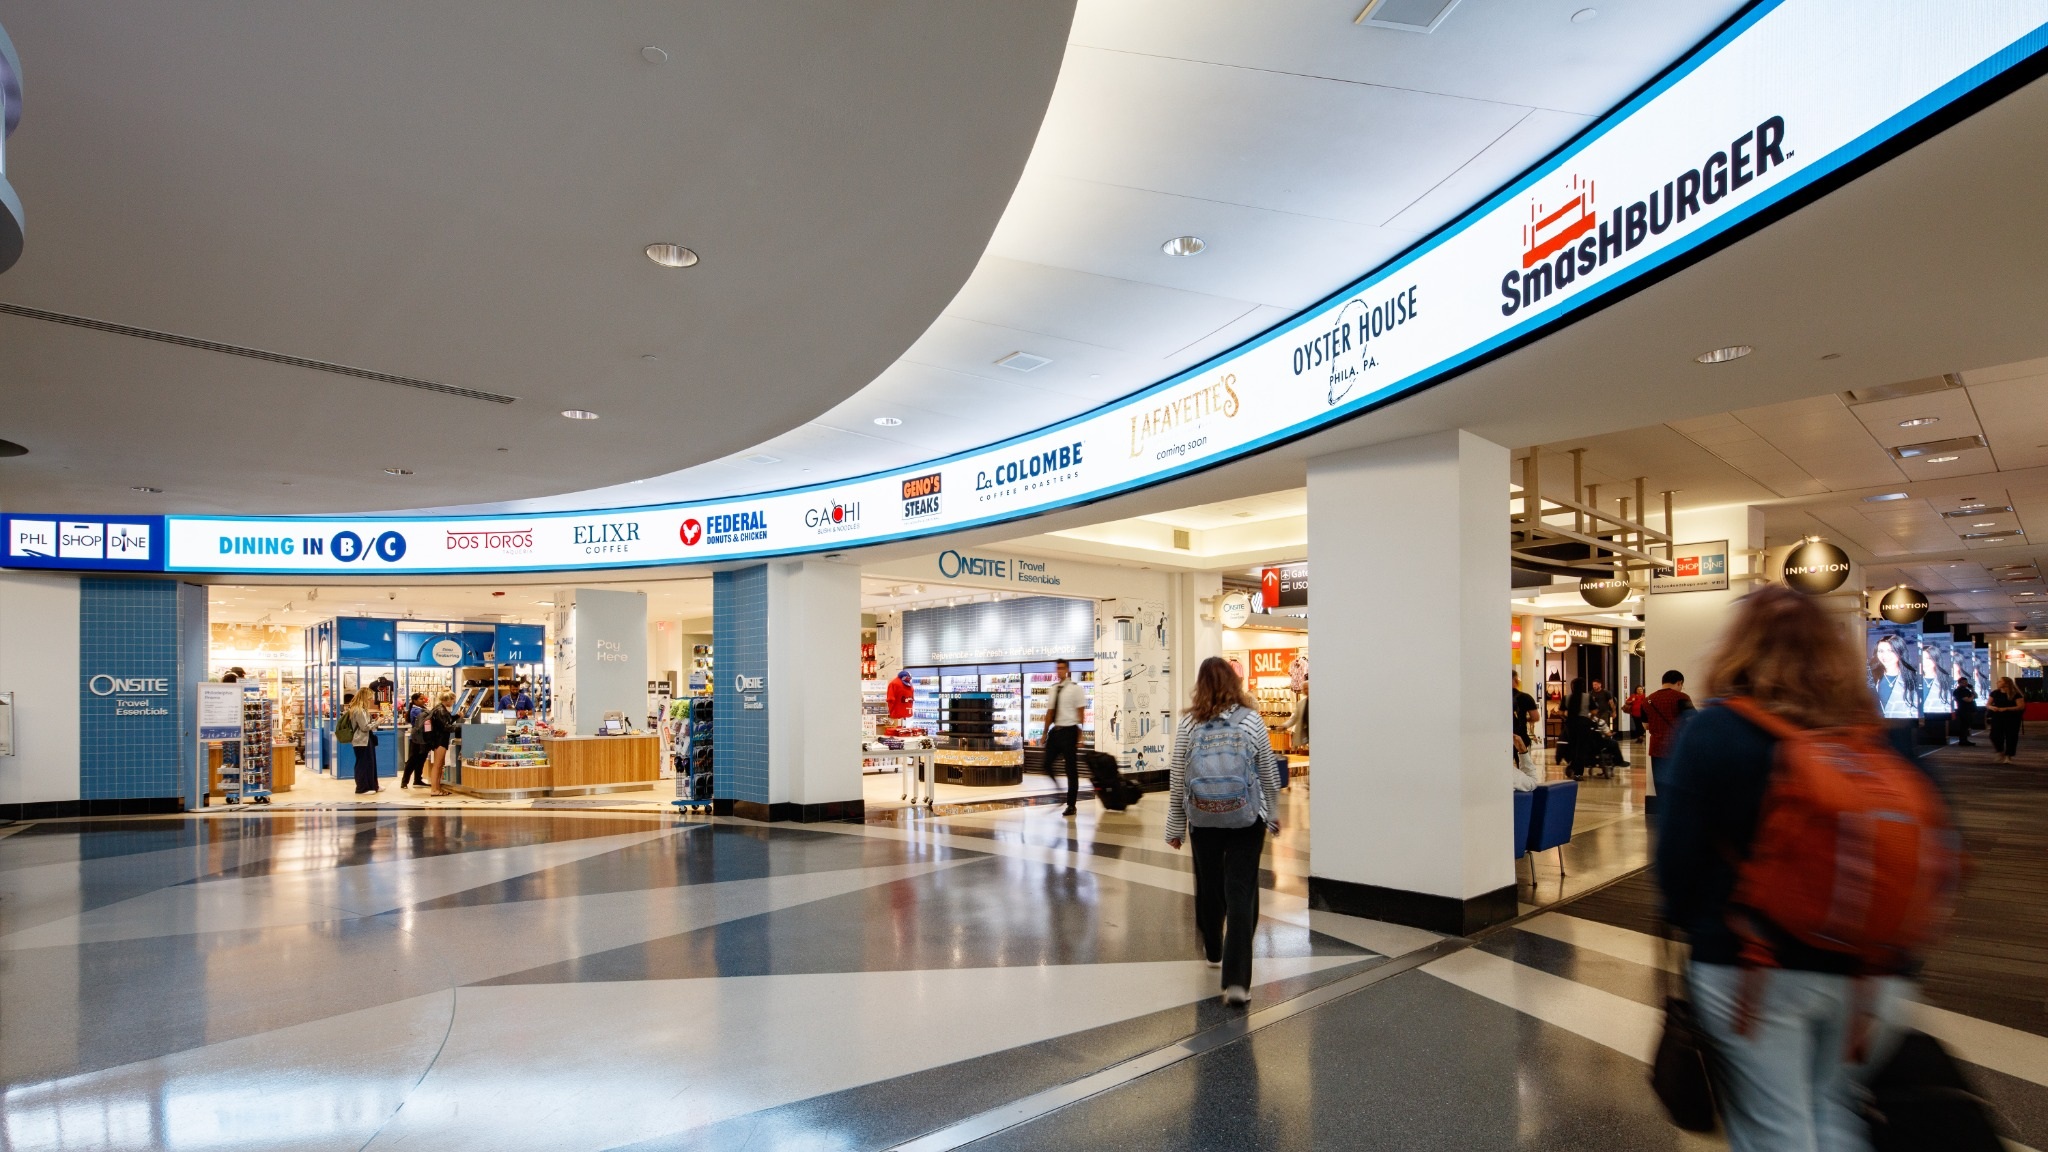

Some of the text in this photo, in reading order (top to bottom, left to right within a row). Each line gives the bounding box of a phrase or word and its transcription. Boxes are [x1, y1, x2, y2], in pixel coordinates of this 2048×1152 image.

[1293, 284, 1417, 376] OYSTER HOUSE
[1329, 356, 1379, 387] PHILA. PA.
[1128, 373, 1240, 460] LAFAYETTE'S
[1156, 436, 1208, 460] coming soon
[975, 441, 1083, 491] La COLOMBE
[903, 475, 940, 499] GENO'S
[979, 471, 1079, 502] COFFEE ROASTERS
[805, 501, 860, 528] GACHI
[904, 496, 939, 517] STEAKS
[706, 510, 768, 535] FEDERAL
[20, 532, 48, 545] PHL
[62, 534, 102, 547] SHOP
[111, 531, 146, 550] DINE
[446, 531, 533, 549] DOS TOROS
[573, 522, 640, 545] ELIXR
[706, 530, 768, 545] DONUTS & CHICKEN
[219, 536, 295, 555] DINING
[302, 537, 324, 555] IN
[585, 544, 628, 554] COFFEE
[1018, 560, 1045, 572] Travel
[1677, 563, 1699, 572] SHOP
[1703, 559, 1724, 570] DINE
[1018, 572, 1061, 585] Essentials
[1568, 629, 1588, 638] COACH
[597, 640, 621, 651] Pay
[597, 652, 629, 662] Here
[1254, 652, 1282, 672] SALE
[116, 699, 149, 707] Travel
[116, 707, 169, 716] Essentials
[1143, 744, 1165, 754] PHILLY
